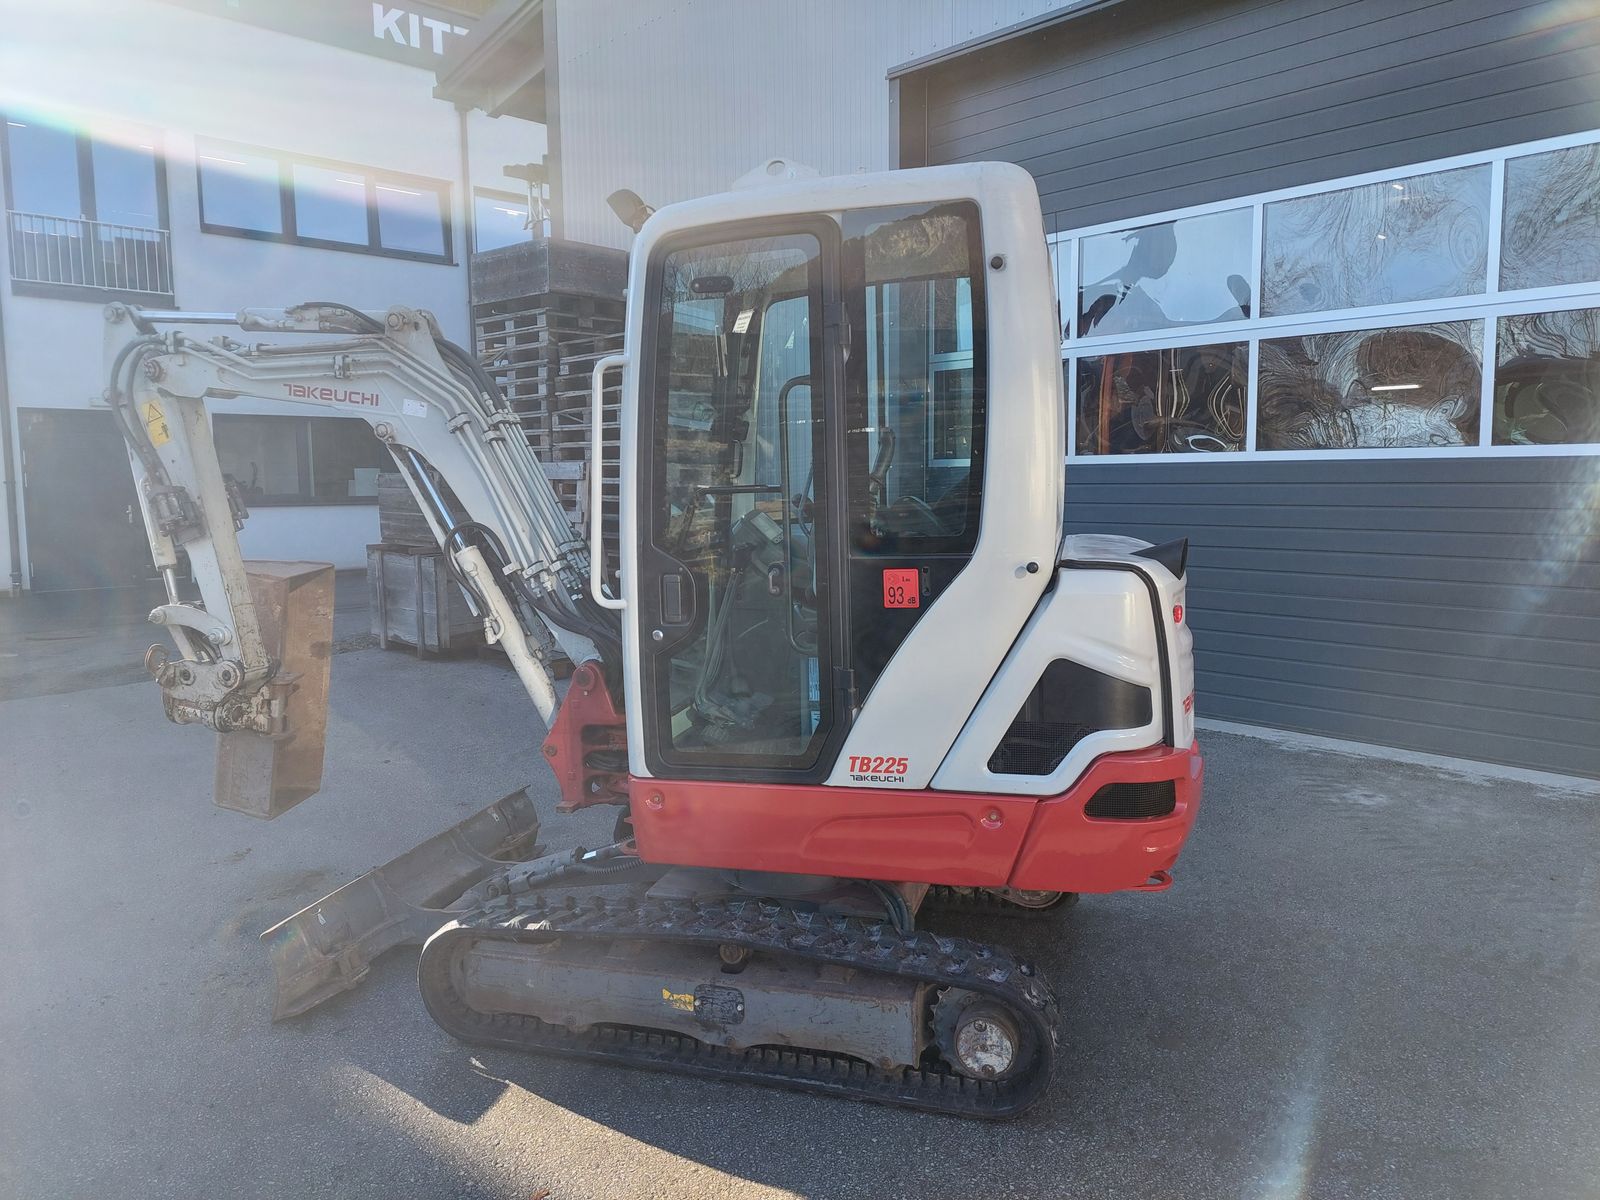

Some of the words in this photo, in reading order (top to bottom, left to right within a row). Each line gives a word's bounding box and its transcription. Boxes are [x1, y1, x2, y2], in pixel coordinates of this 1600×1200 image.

[372, 2, 470, 55] KIT
[888, 586, 904, 605] 93
[907, 596, 917, 605] dB
[849, 756, 909, 775] TB225
